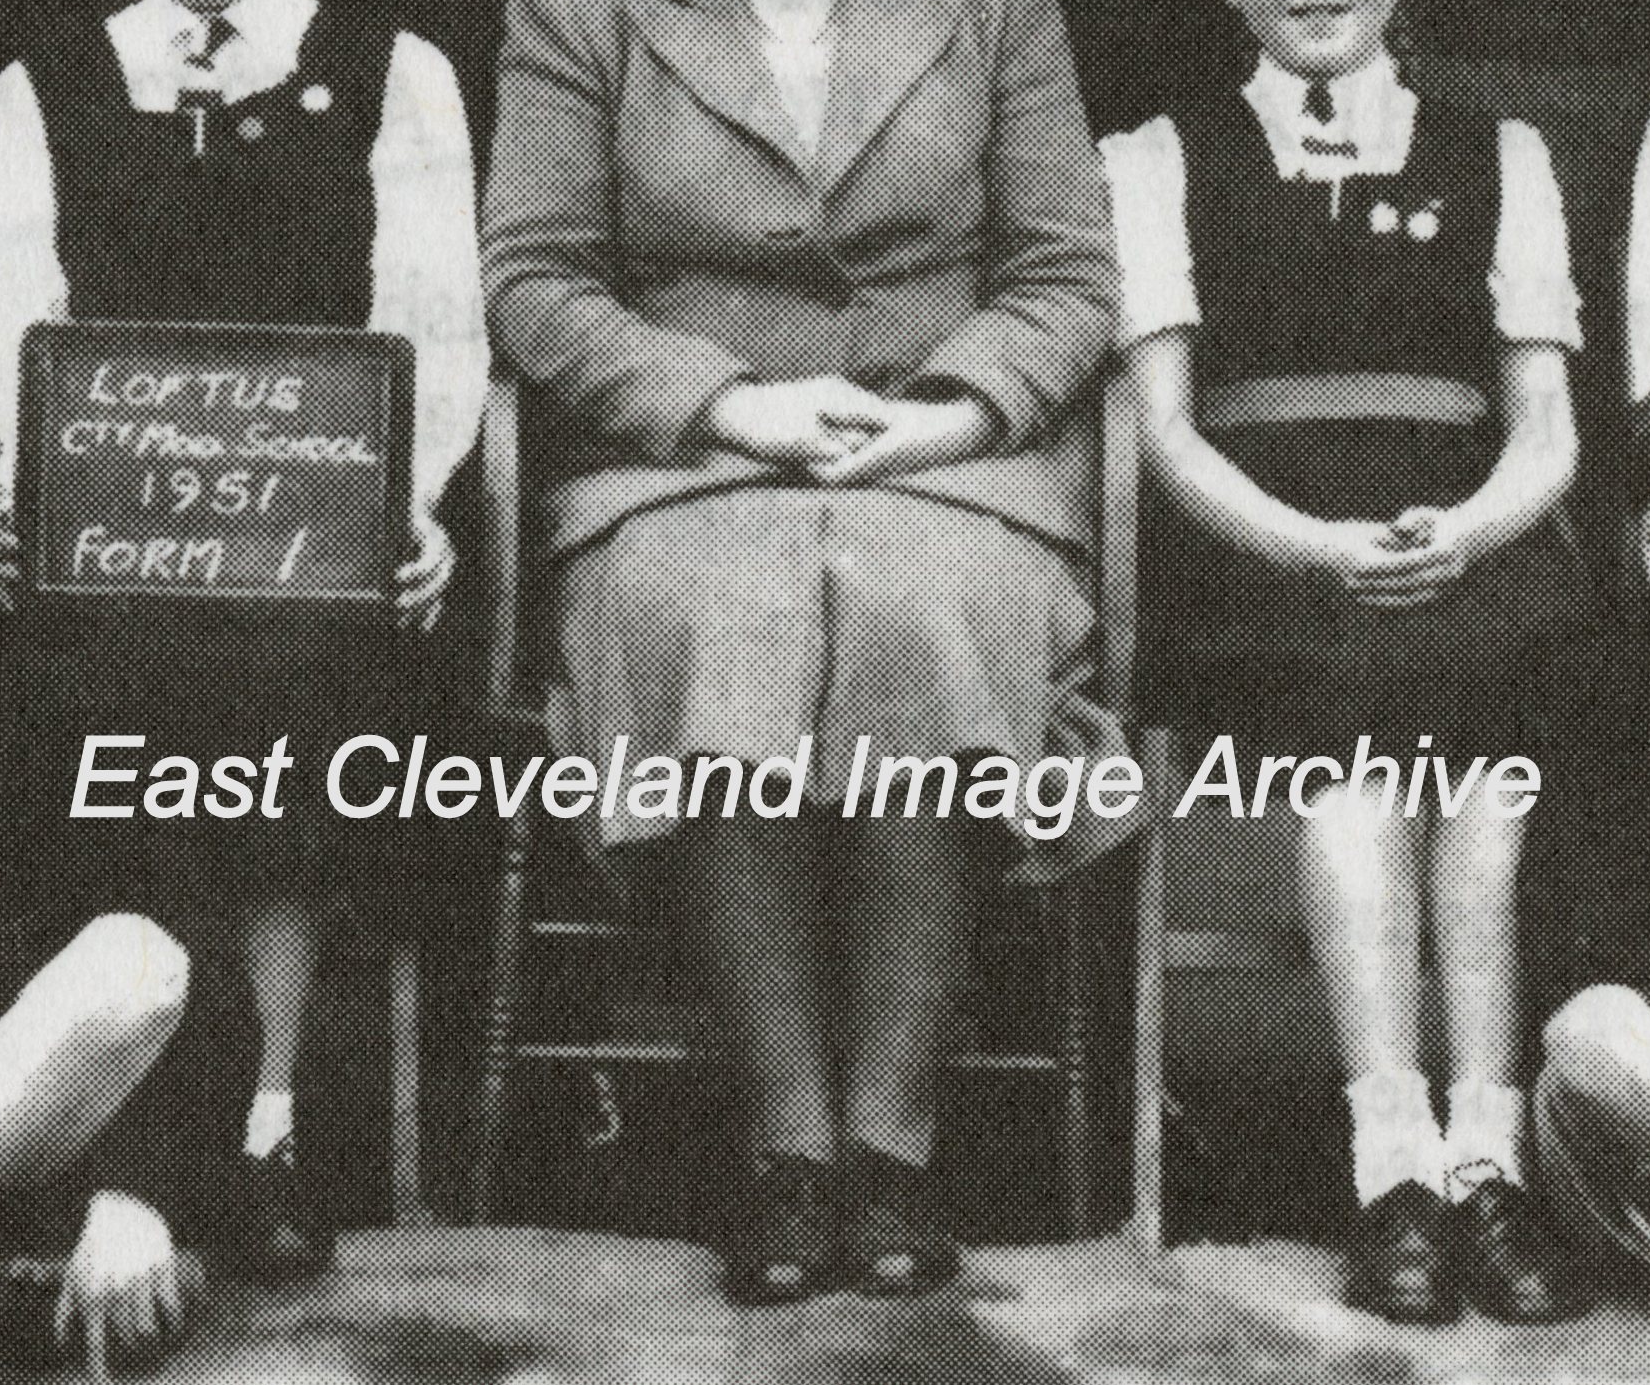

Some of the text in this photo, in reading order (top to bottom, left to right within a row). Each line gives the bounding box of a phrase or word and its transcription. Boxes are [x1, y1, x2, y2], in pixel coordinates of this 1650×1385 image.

[88, 363, 304, 412] LOFTUS
[238, 422, 378, 465] SCHOOL
[141, 469, 282, 514] 1951
[73, 524, 225, 584] FORM
